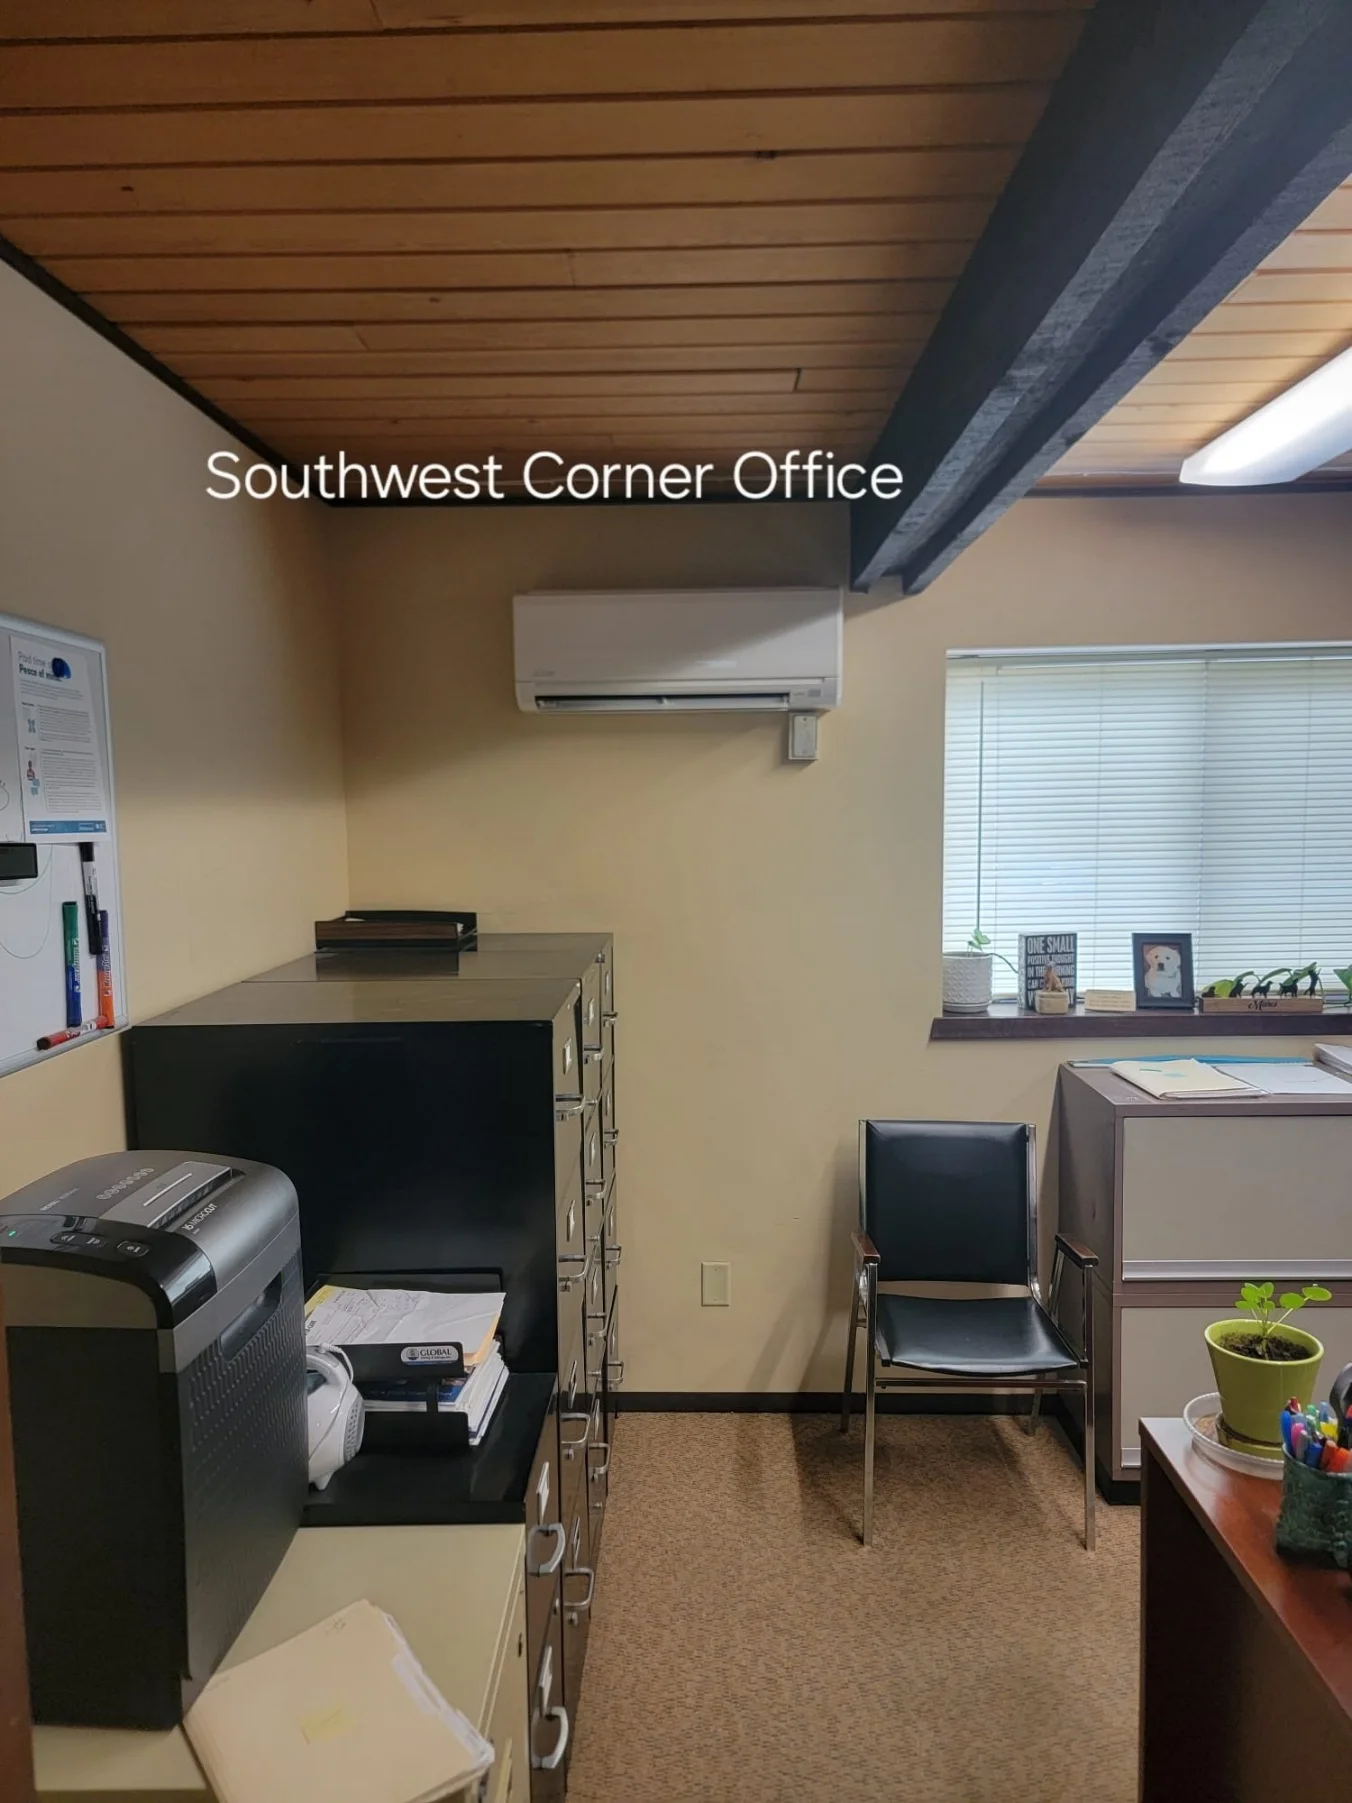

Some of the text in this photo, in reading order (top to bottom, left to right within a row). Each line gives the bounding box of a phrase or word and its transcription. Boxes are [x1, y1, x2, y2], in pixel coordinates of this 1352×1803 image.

[1027, 935, 1074, 954] ONE SMALL
[1027, 966, 1034, 978] IN
[419, 1348, 452, 1357] GLOBAL
